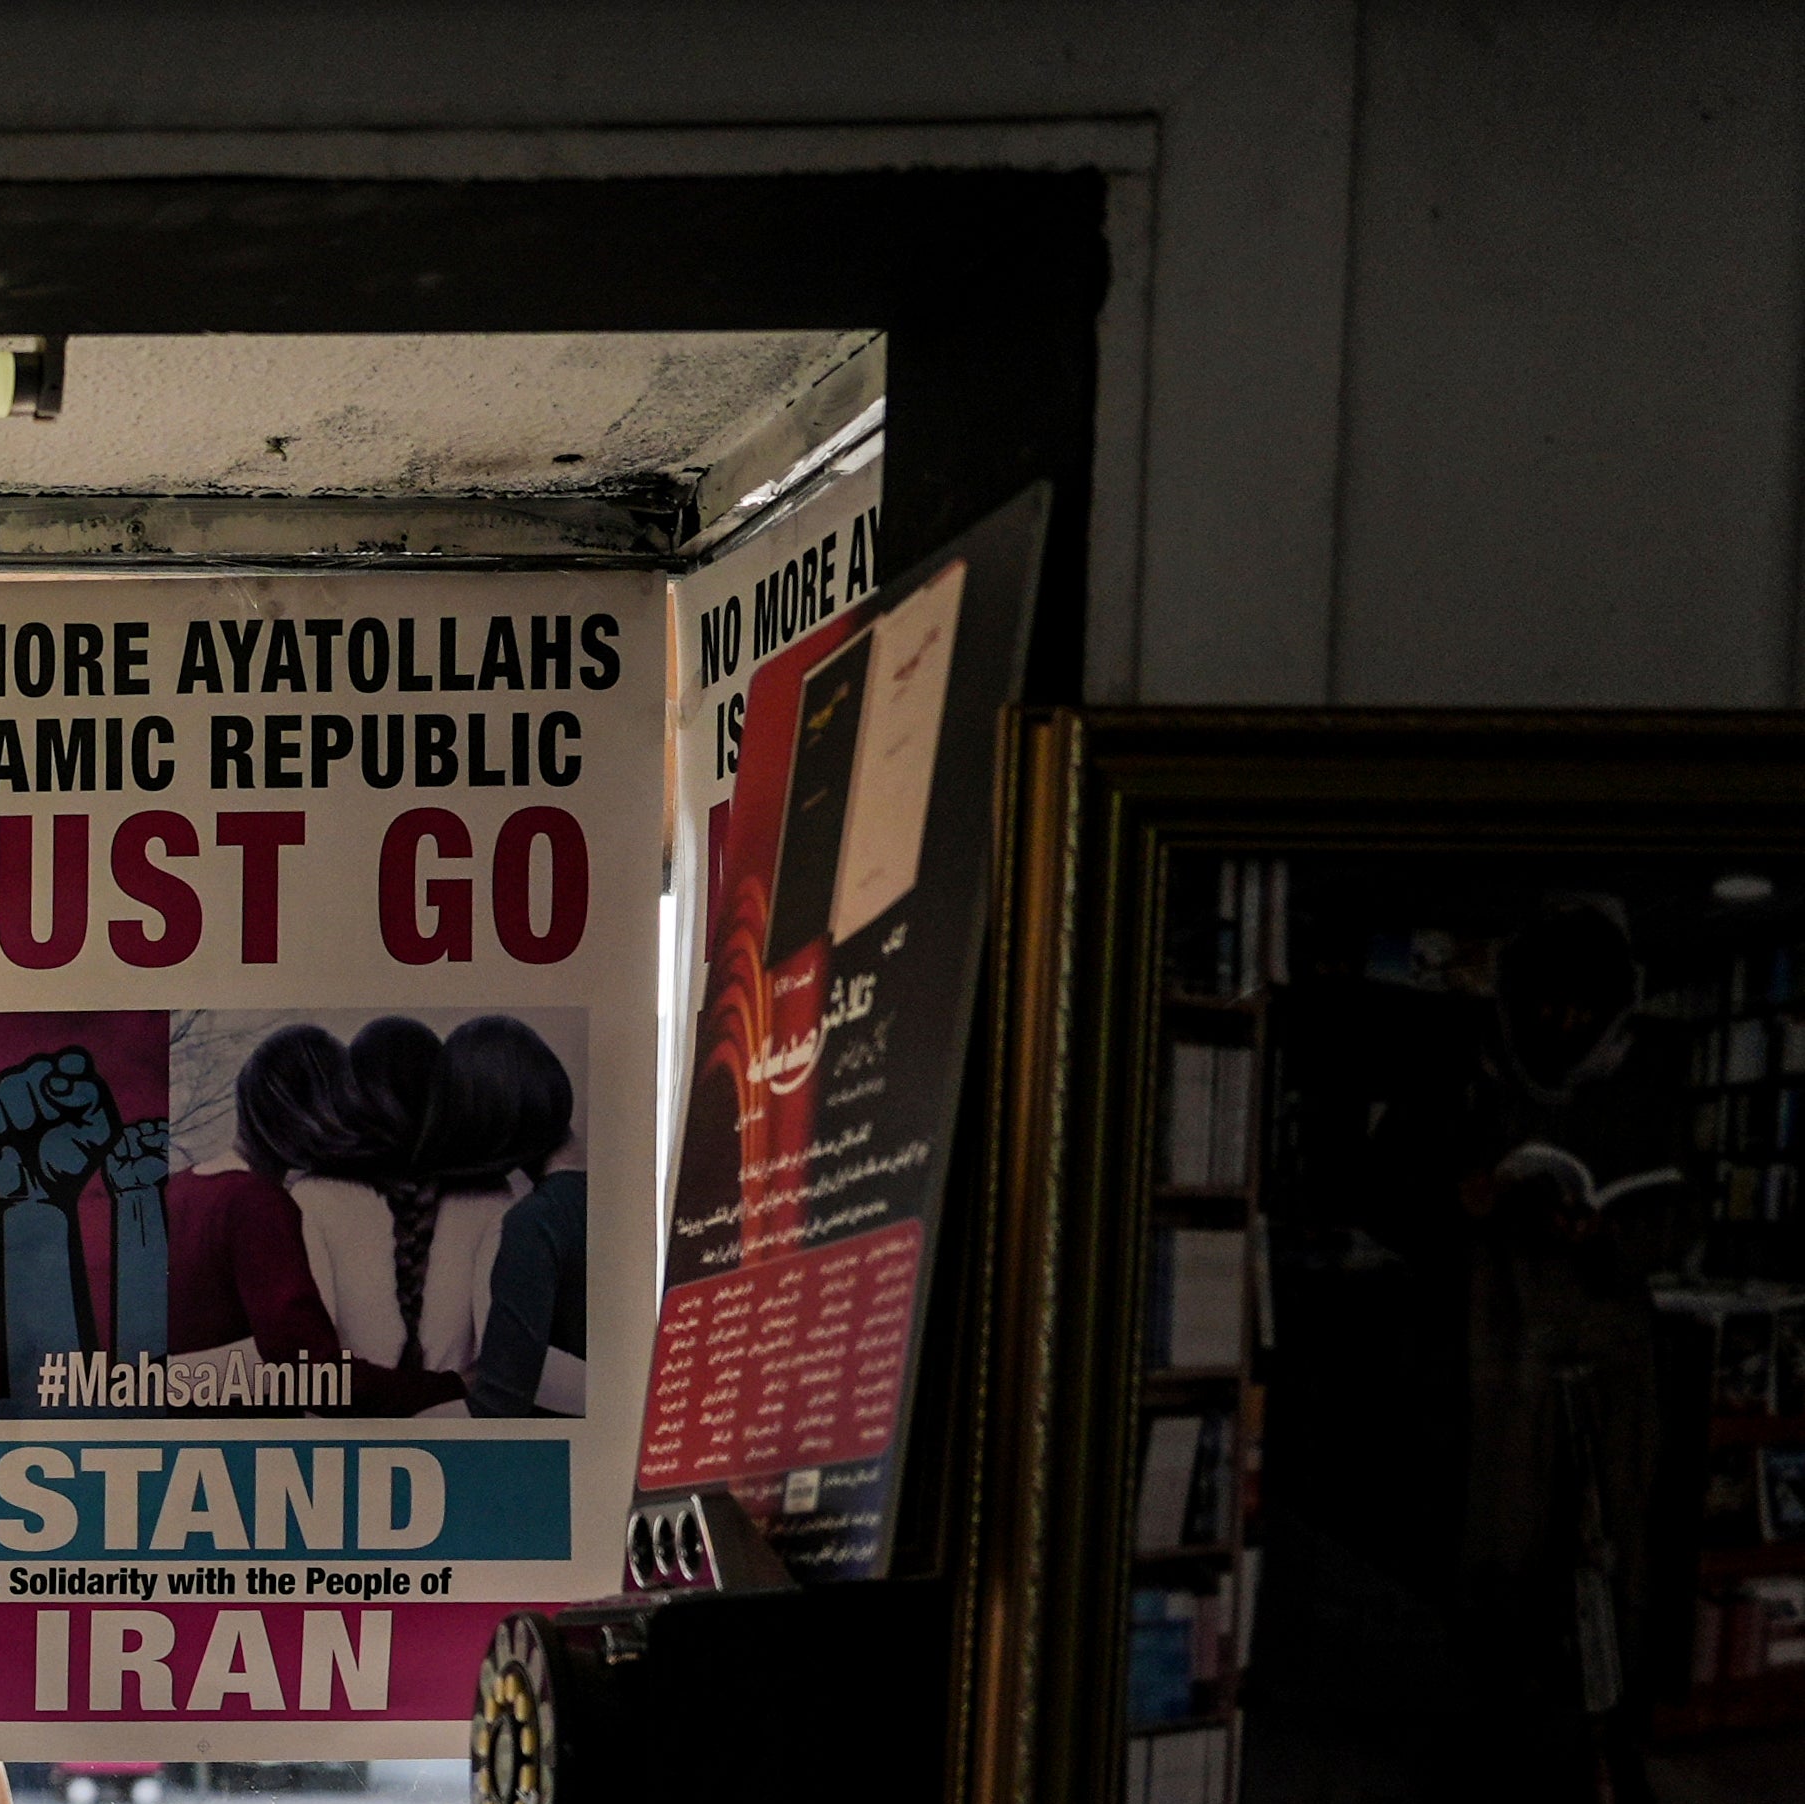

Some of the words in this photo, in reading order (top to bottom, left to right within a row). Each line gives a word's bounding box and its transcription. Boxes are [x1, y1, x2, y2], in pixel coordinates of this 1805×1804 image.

[701, 596, 741, 688] NO
[754, 531, 837, 659] MORE
[177, 613, 621, 694] AYATOLLAHS
[210, 710, 582, 789] REPUBLIC
[378, 805, 589, 965] GO
[37, 1349, 353, 1408] #MahsaAmini
[9, 1566, 160, 1600] Solidarity
[167, 1567, 236, 1595] with
[246, 1567, 297, 1595] the
[305, 1568, 414, 1600] People
[419, 1566, 454, 1595] of
[34, 1609, 393, 1712] IRAN
